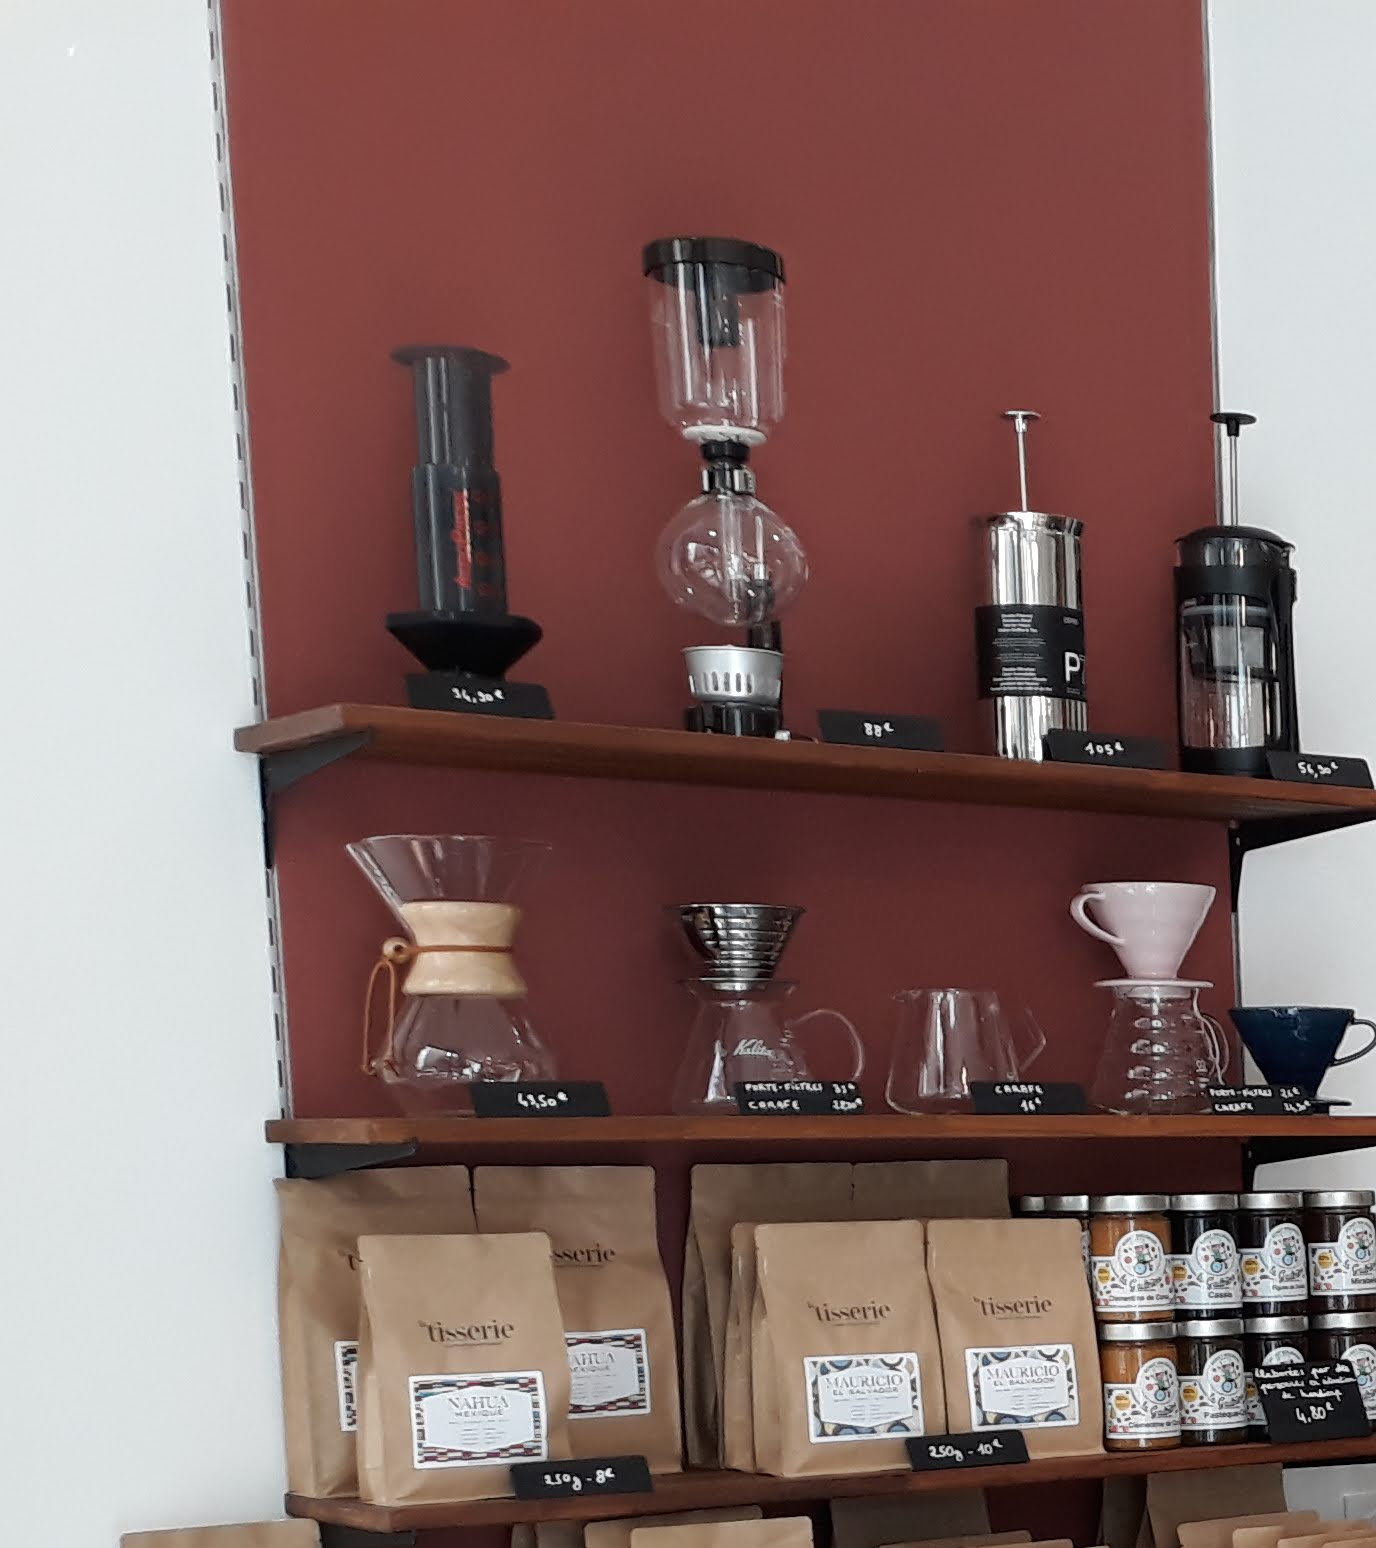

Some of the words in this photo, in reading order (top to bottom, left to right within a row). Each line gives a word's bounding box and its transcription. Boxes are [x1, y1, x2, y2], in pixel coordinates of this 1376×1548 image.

[552, 1242, 616, 1264] sserie
[813, 1301, 891, 1322] tisserie
[979, 1296, 1053, 1316] tisserie
[424, 1320, 514, 1343] tisserie
